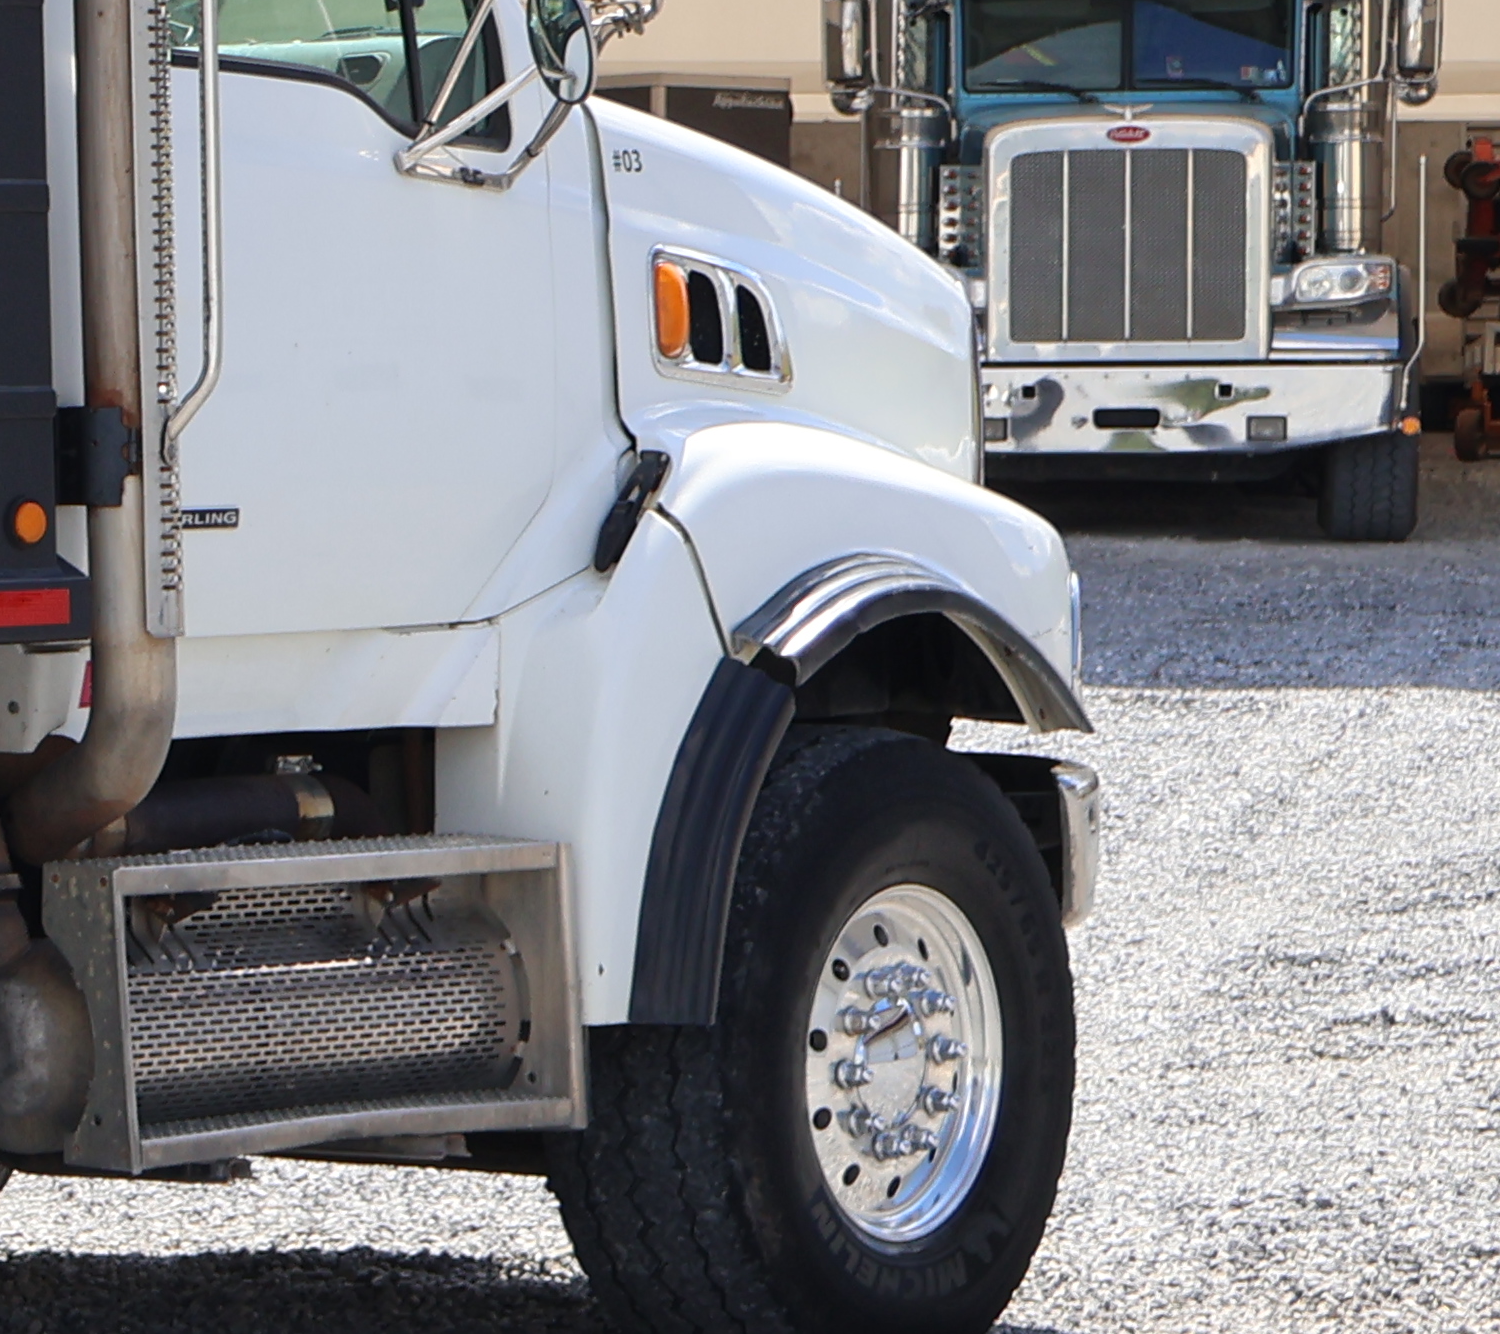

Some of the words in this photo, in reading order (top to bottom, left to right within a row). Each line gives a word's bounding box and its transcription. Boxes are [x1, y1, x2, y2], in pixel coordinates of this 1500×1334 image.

[612, 149, 643, 173] #03
[180, 511, 237, 525] RLING
[811, 1199, 967, 1298] MICHELIN
